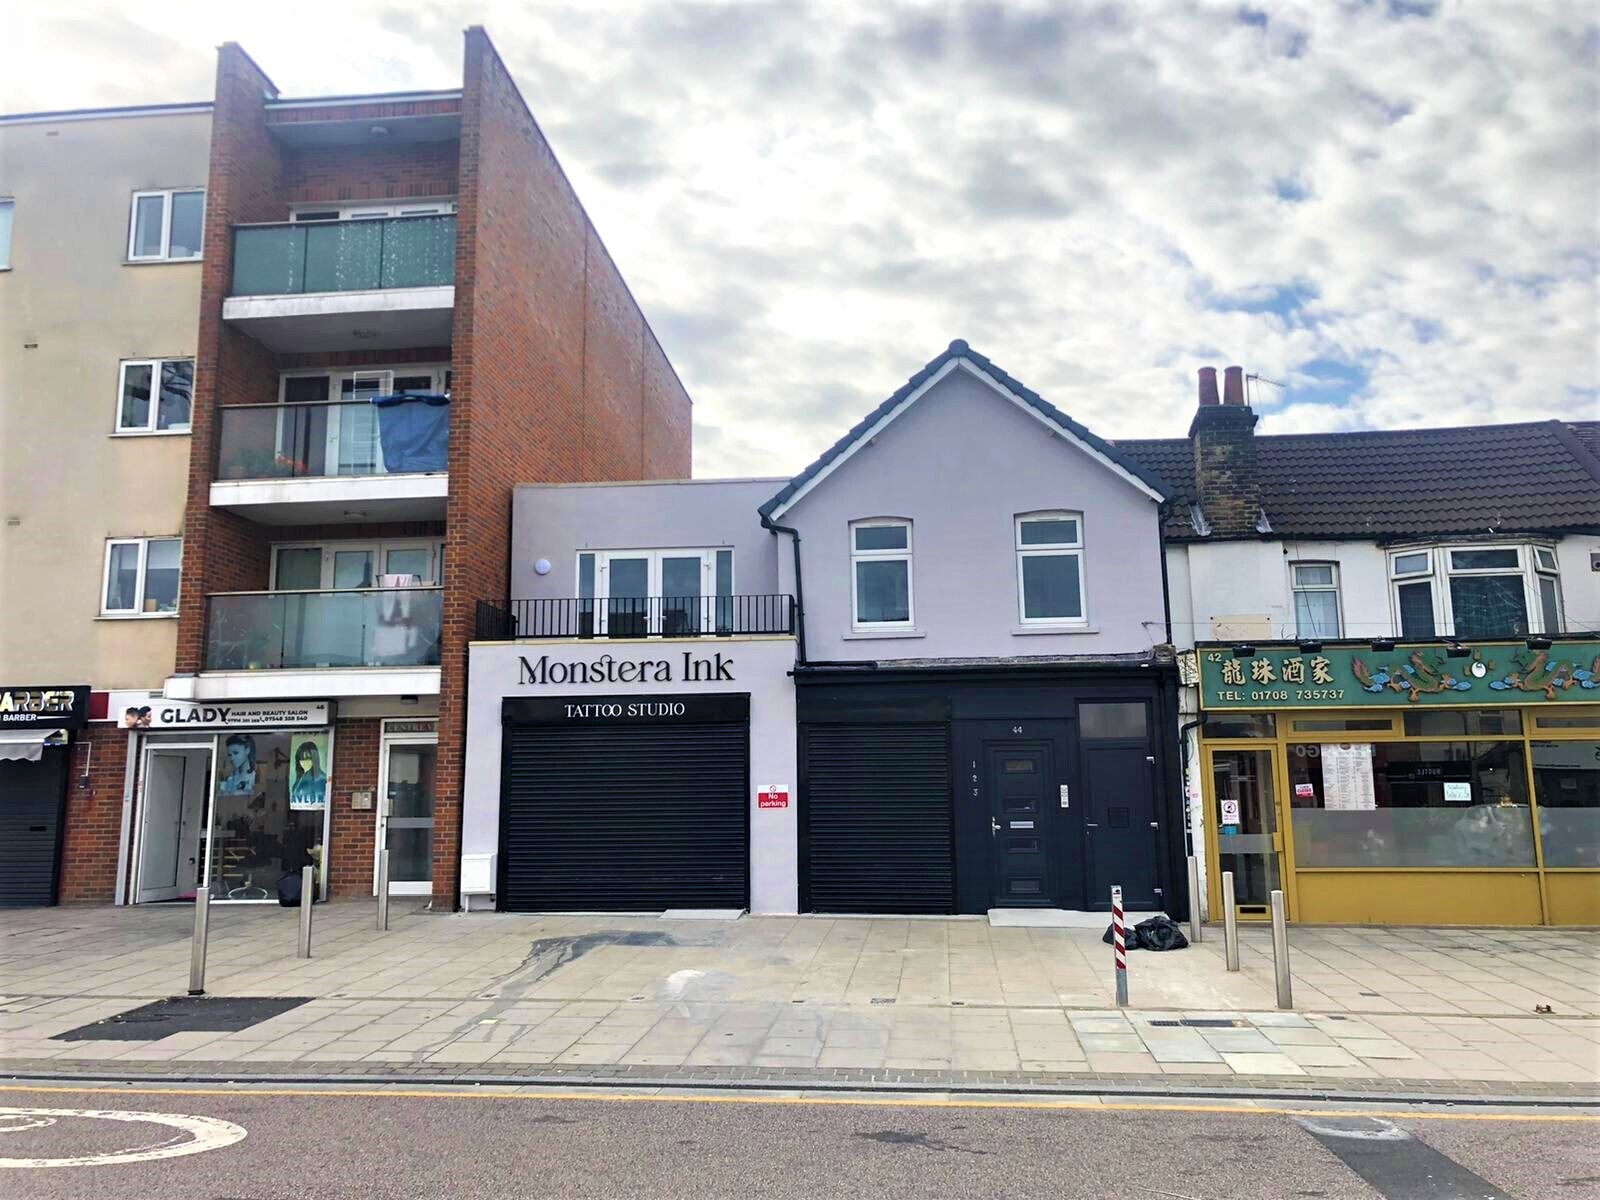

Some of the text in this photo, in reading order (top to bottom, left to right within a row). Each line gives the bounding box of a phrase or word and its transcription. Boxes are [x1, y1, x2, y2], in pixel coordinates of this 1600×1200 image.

[1207, 652, 1222, 662] 42
[518, 652, 736, 685] Monstera Ink
[1221, 656, 1334, 685] 龍珠酒家
[0, 691, 74, 712] ARBER
[1217, 689, 1345, 701] TEL: 01708 735737
[3, 713, 37, 721] BARBER
[161, 707, 231, 723] GLADY
[564, 702, 685, 718] TATTOO STUDIO
